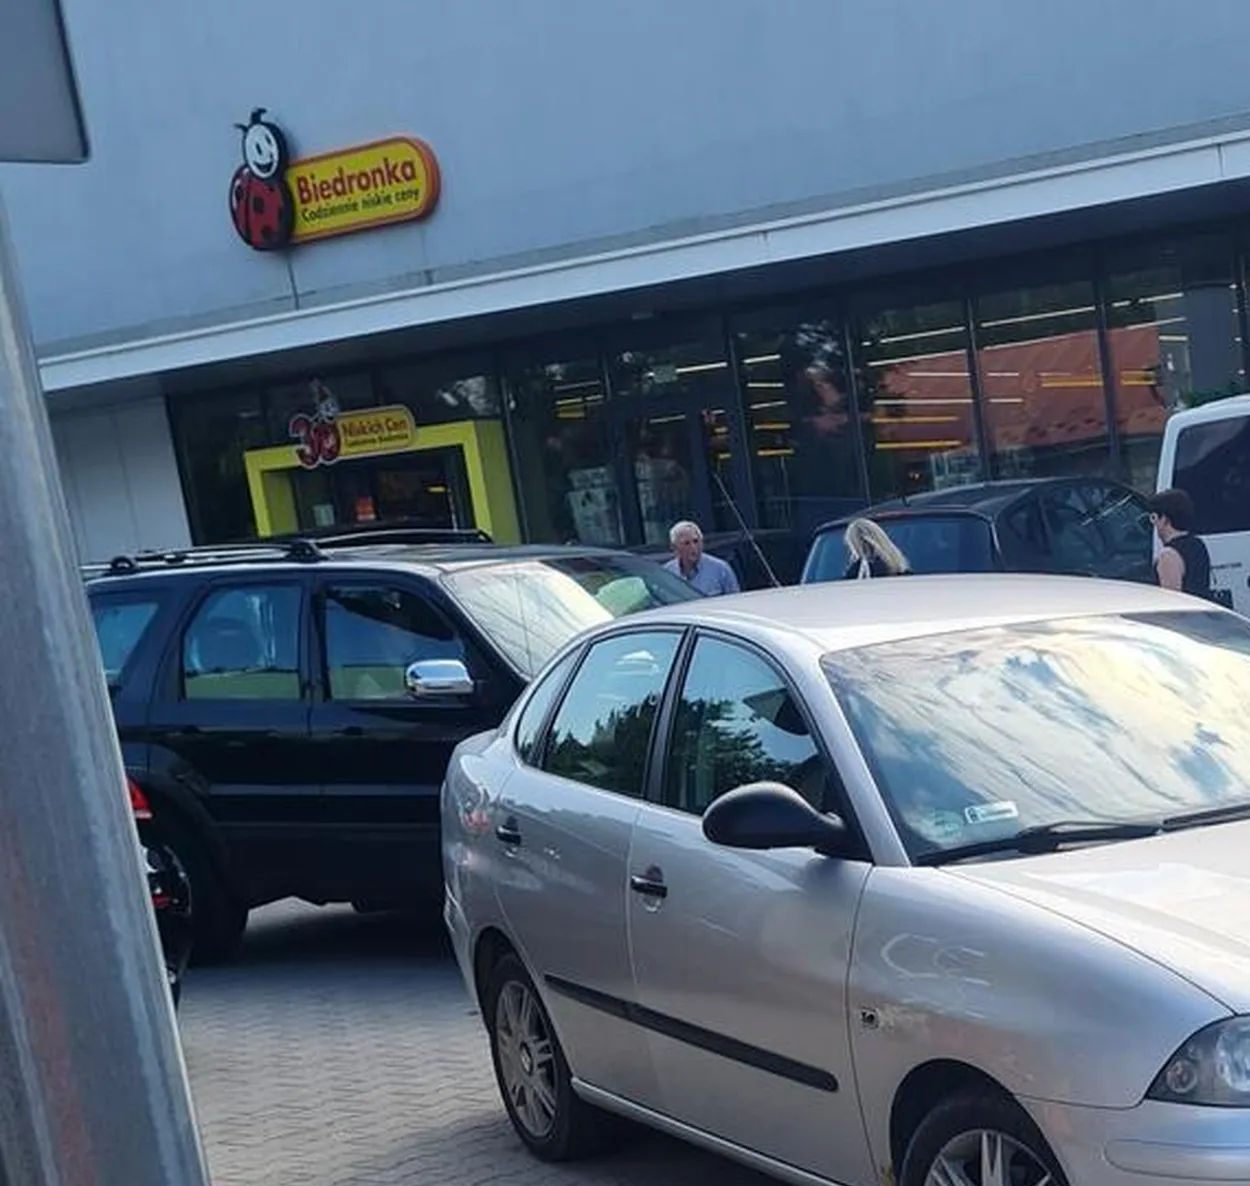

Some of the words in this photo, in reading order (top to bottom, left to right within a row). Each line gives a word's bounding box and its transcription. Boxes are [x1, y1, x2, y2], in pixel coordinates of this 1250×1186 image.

[296, 157, 417, 204] Biedronka
[301, 198, 358, 222] Codziennie
[361, 190, 393, 209] niskie
[395, 187, 419, 203] ceny
